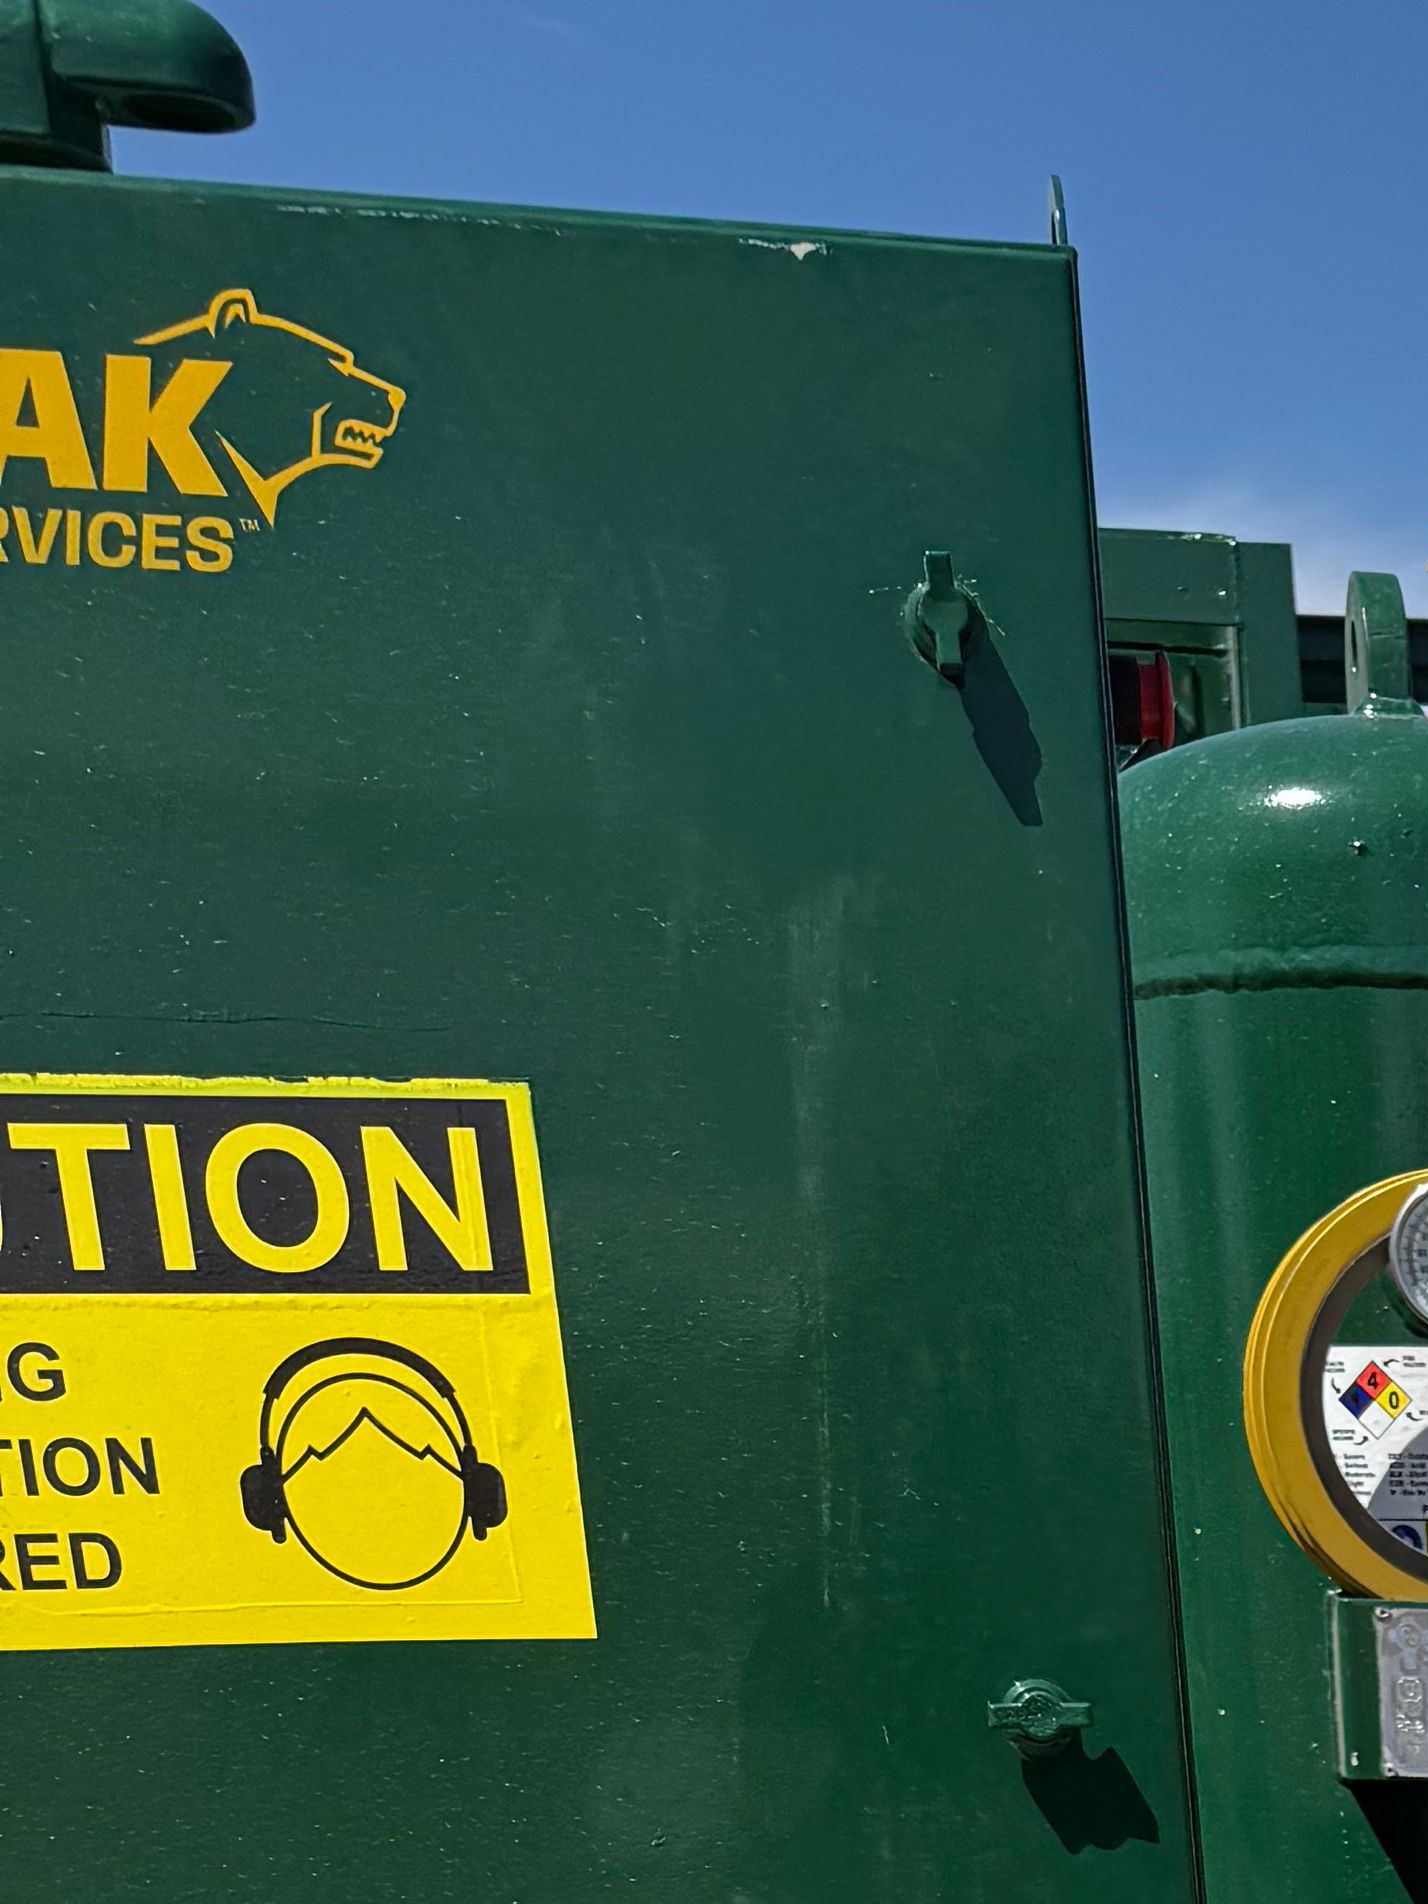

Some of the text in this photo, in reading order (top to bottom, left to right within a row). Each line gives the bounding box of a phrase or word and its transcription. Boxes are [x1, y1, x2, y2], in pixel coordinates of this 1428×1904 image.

[0, 347, 232, 497] AK
[0, 505, 234, 573] VICES
[0, 1122, 493, 1273] TION
[0, 1342, 66, 1401] G
[1368, 1372, 1378, 1390] 4
[1389, 1391, 1399, 1409] 0
